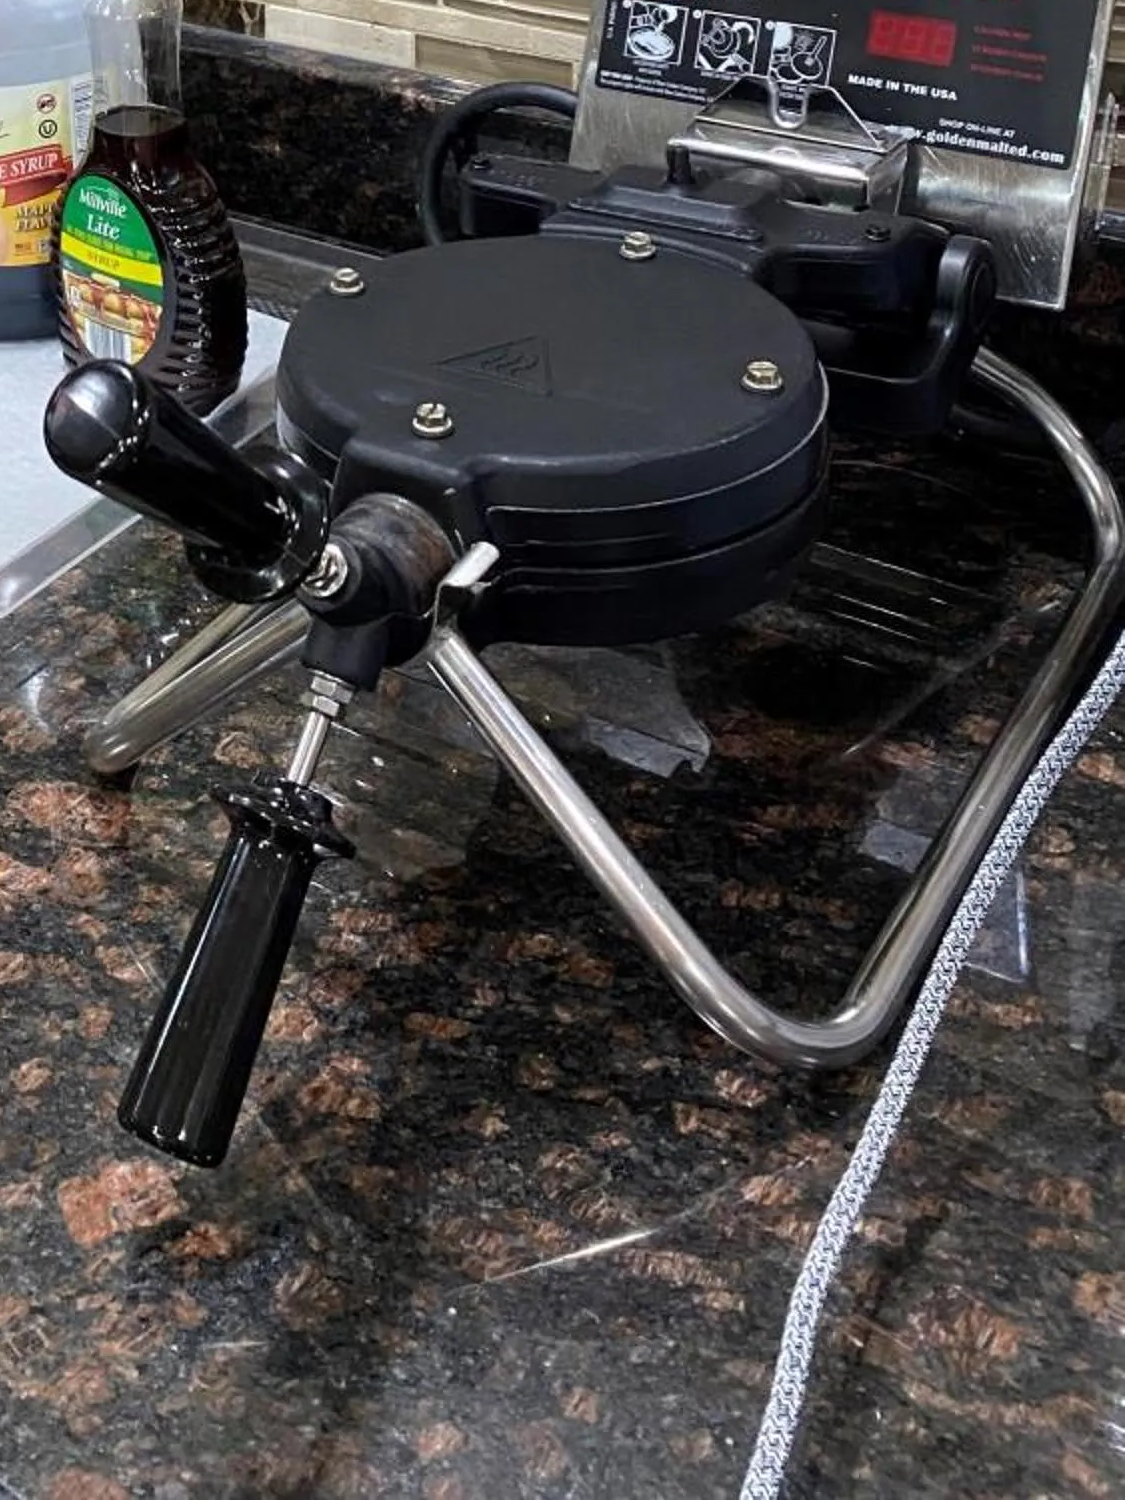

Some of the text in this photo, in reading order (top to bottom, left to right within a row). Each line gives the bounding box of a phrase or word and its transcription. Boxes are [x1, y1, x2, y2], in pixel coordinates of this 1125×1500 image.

[847, 73, 958, 101] MADE IN THE USA
[938, 117, 965, 131] SHOP
[1003, 128, 1016, 139] AT
[9, 152, 60, 178] SYRUP
[78, 186, 127, 219] Millville
[86, 213, 121, 240] Lite
